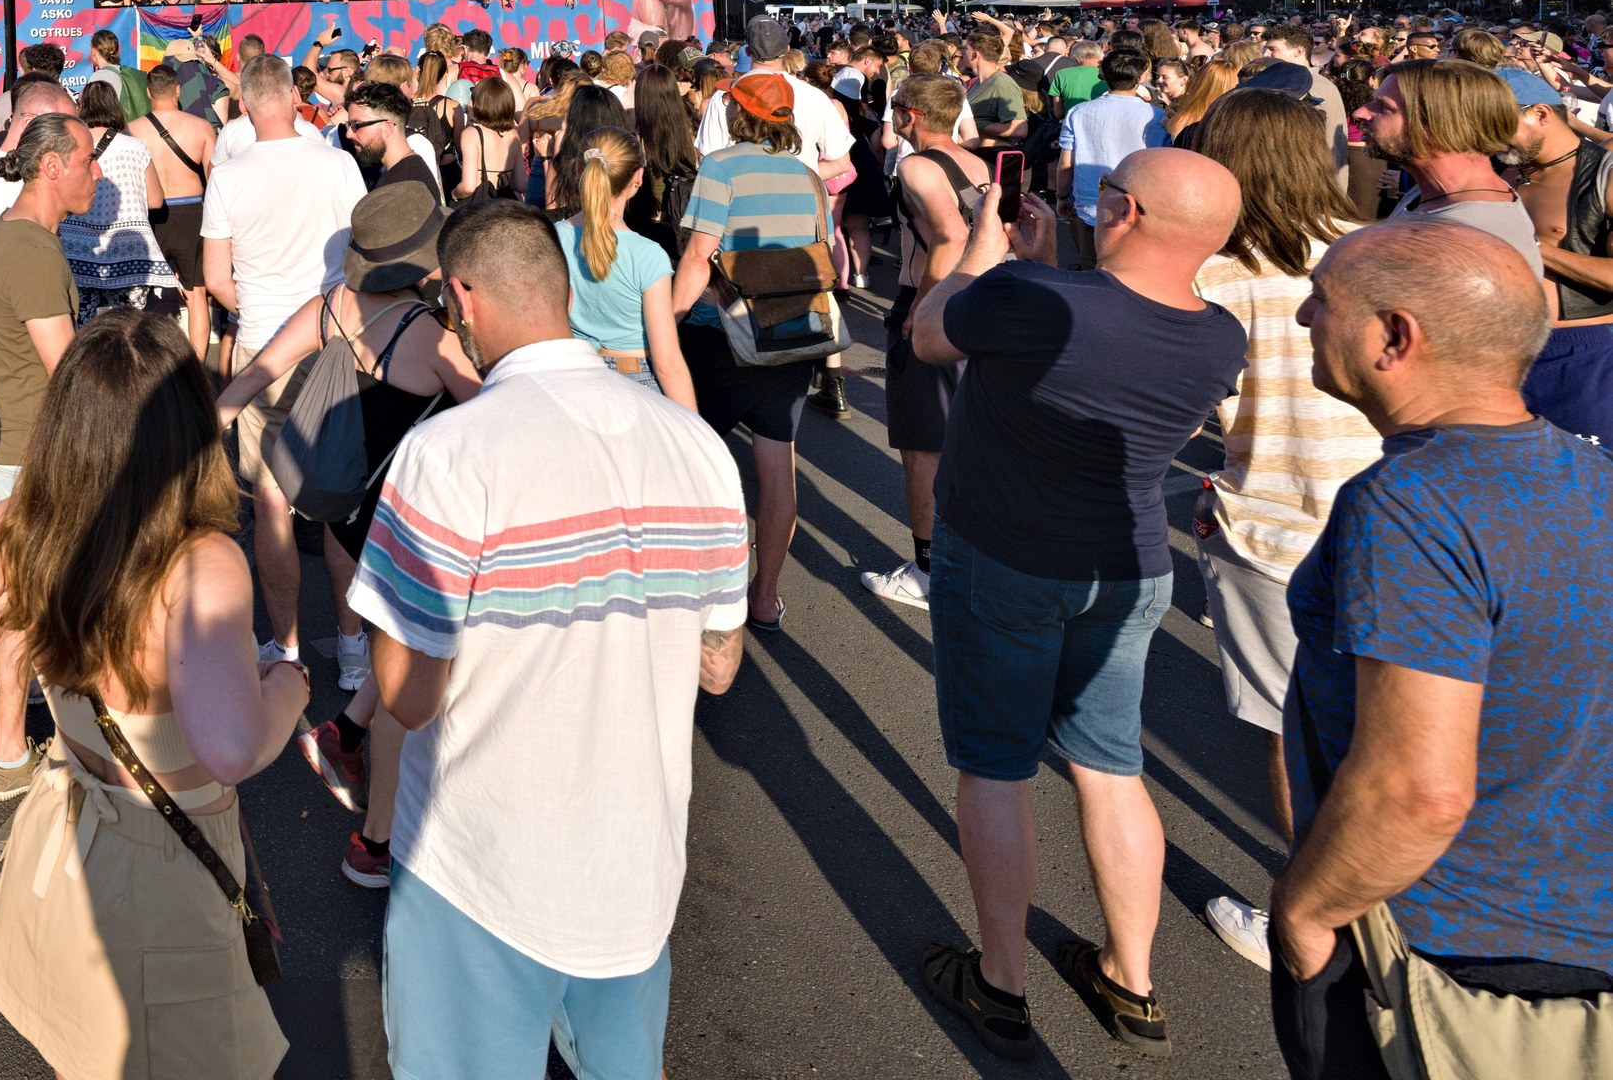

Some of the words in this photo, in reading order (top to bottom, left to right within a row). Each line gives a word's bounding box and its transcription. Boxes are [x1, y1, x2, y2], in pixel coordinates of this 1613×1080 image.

[41, 9, 73, 19] ASKO
[30, 27, 83, 38] OGTRUES
[530, 39, 582, 60] MUC
[58, 76, 87, 87] ARIO
